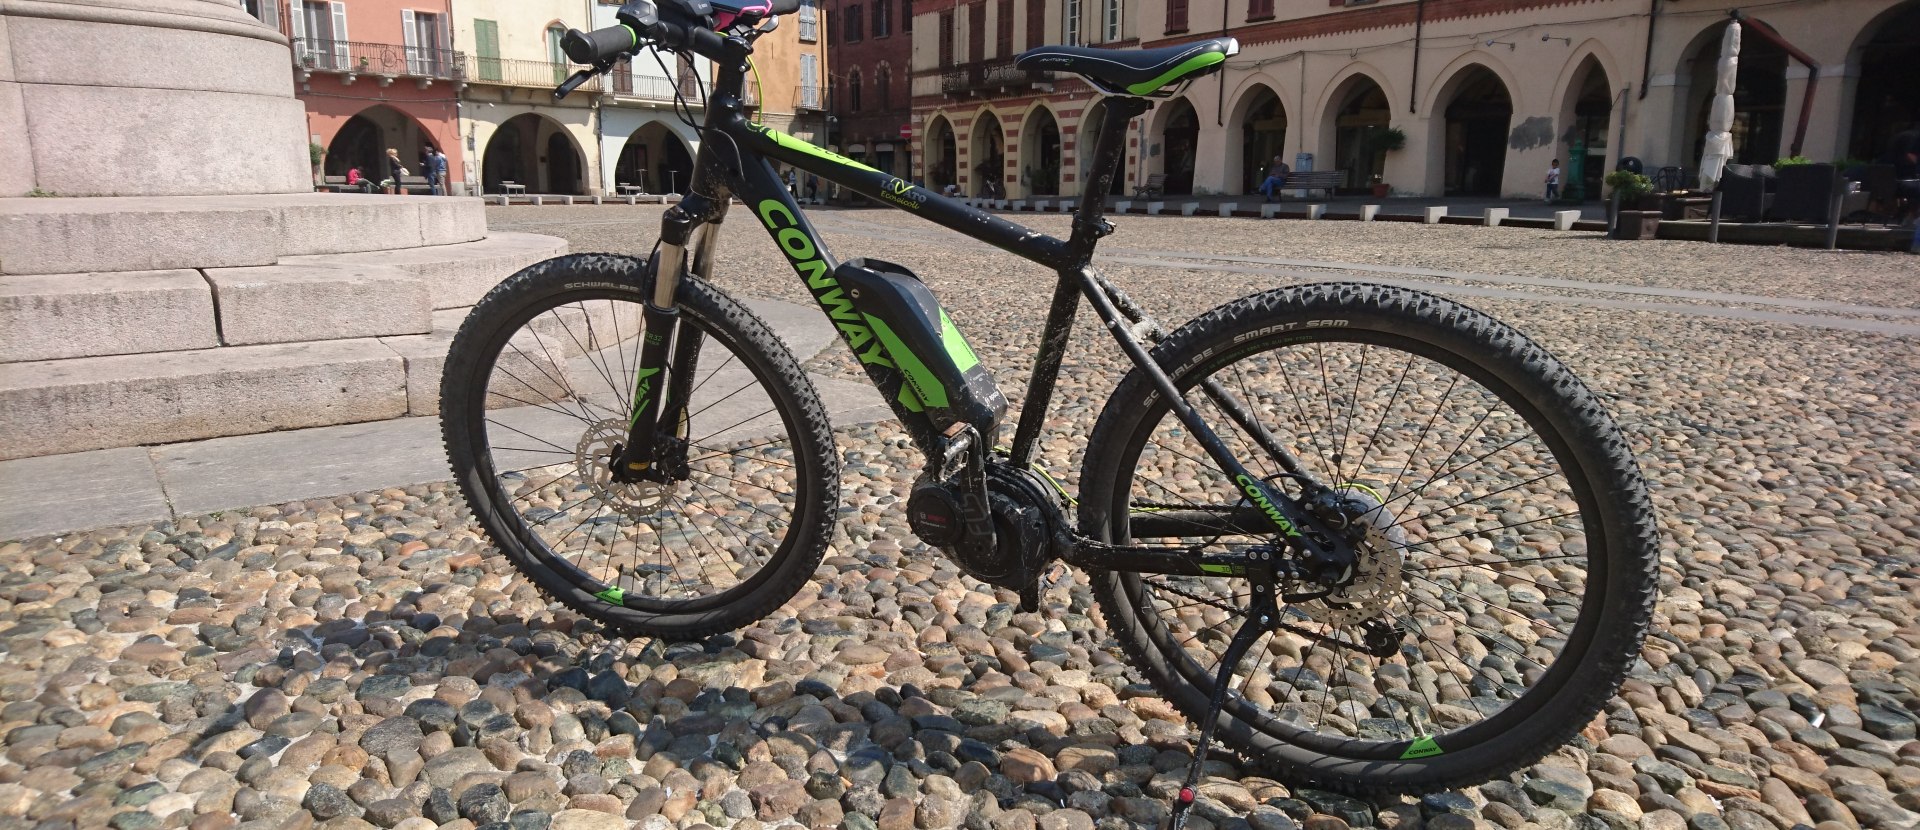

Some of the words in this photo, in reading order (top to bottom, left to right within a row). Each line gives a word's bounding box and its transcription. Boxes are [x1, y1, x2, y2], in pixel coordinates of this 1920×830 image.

[564, 281, 640, 292] SCHWALBE
[759, 199, 895, 369] CONWAY
[1233, 321, 1298, 344] SMART
[1306, 318, 1349, 328] SAM
[904, 368, 929, 402] CONWAY
[1236, 474, 1302, 538] CONWAY
[1408, 747, 1437, 755] CONWAY
